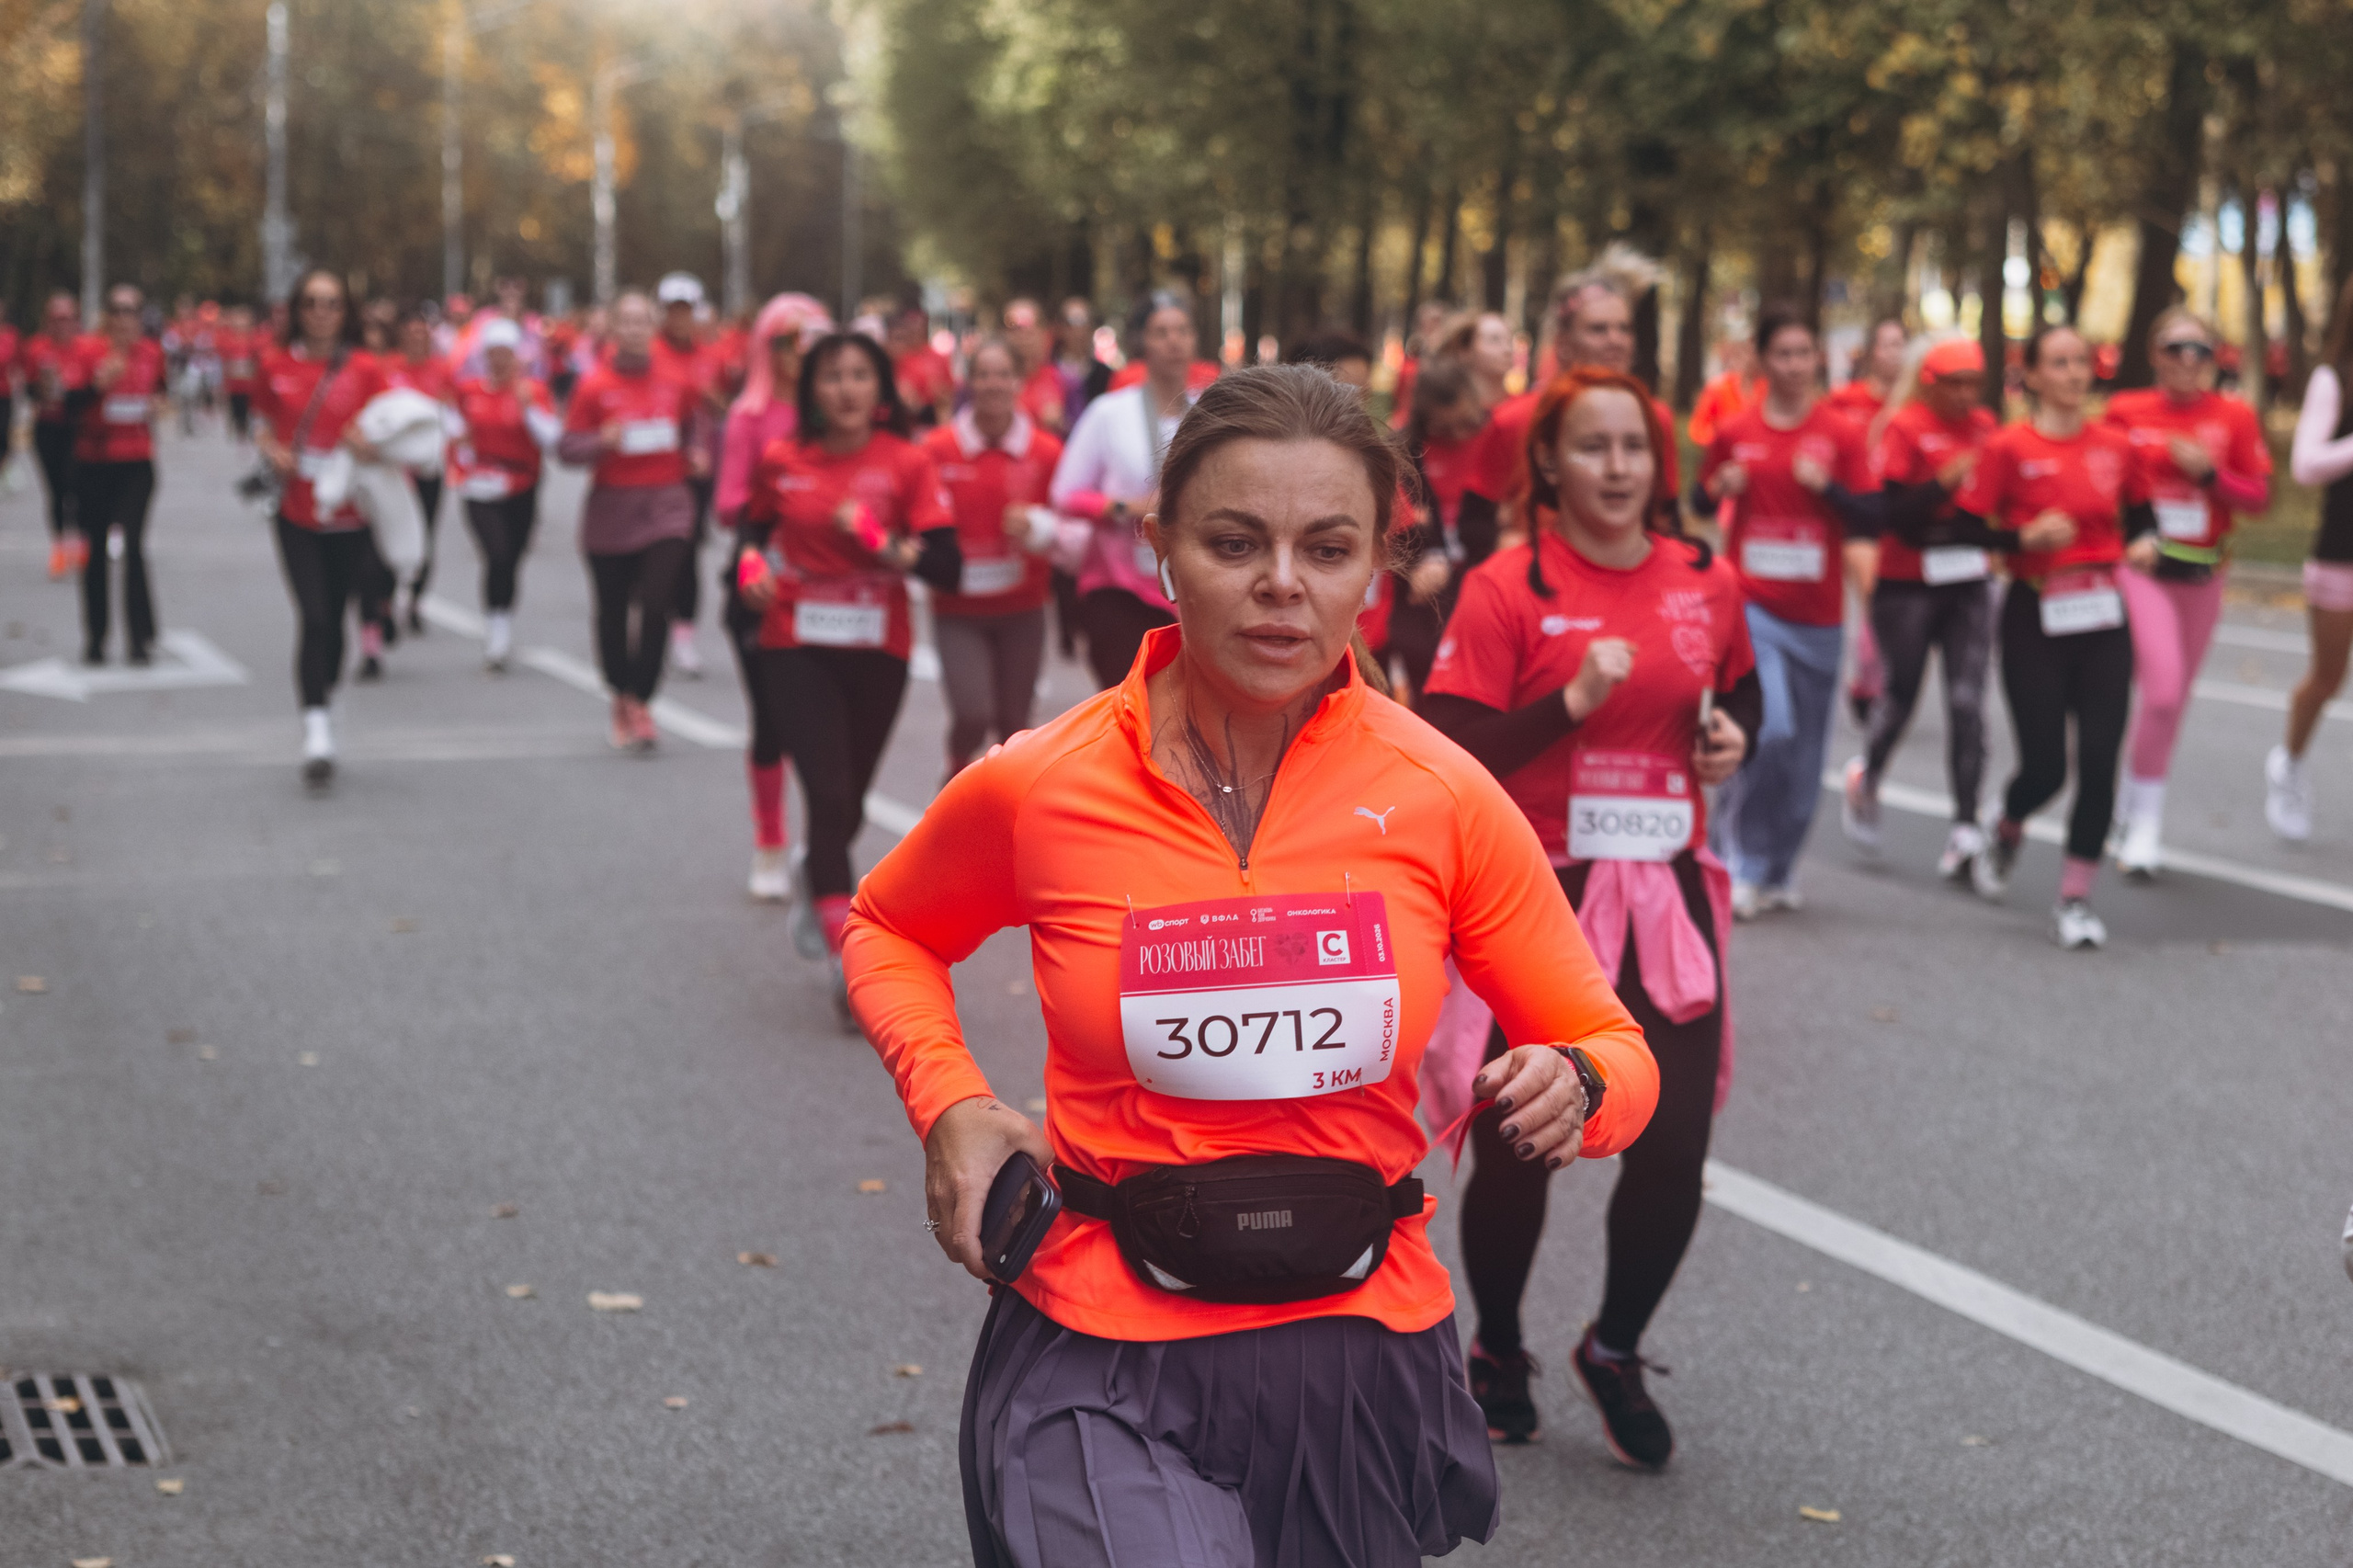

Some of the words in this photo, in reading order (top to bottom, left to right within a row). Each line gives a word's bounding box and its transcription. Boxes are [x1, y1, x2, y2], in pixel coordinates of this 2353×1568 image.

[1576, 807, 1683, 839] 30820
[1211, 914, 1239, 923] ВФЛА
[1287, 908, 1336, 917] ОНКОЛОГИКА
[1140, 935, 1216, 975] РОЗОВЫЙ
[1218, 936, 1267, 970] ЗАБЕГ
[1155, 1006, 1347, 1061] 30712
[1379, 997, 1394, 1062] МОСКВА
[1313, 1072, 1325, 1089] 3
[1331, 1067, 1362, 1086] КМ
[1237, 1210, 1293, 1231] PUMA
